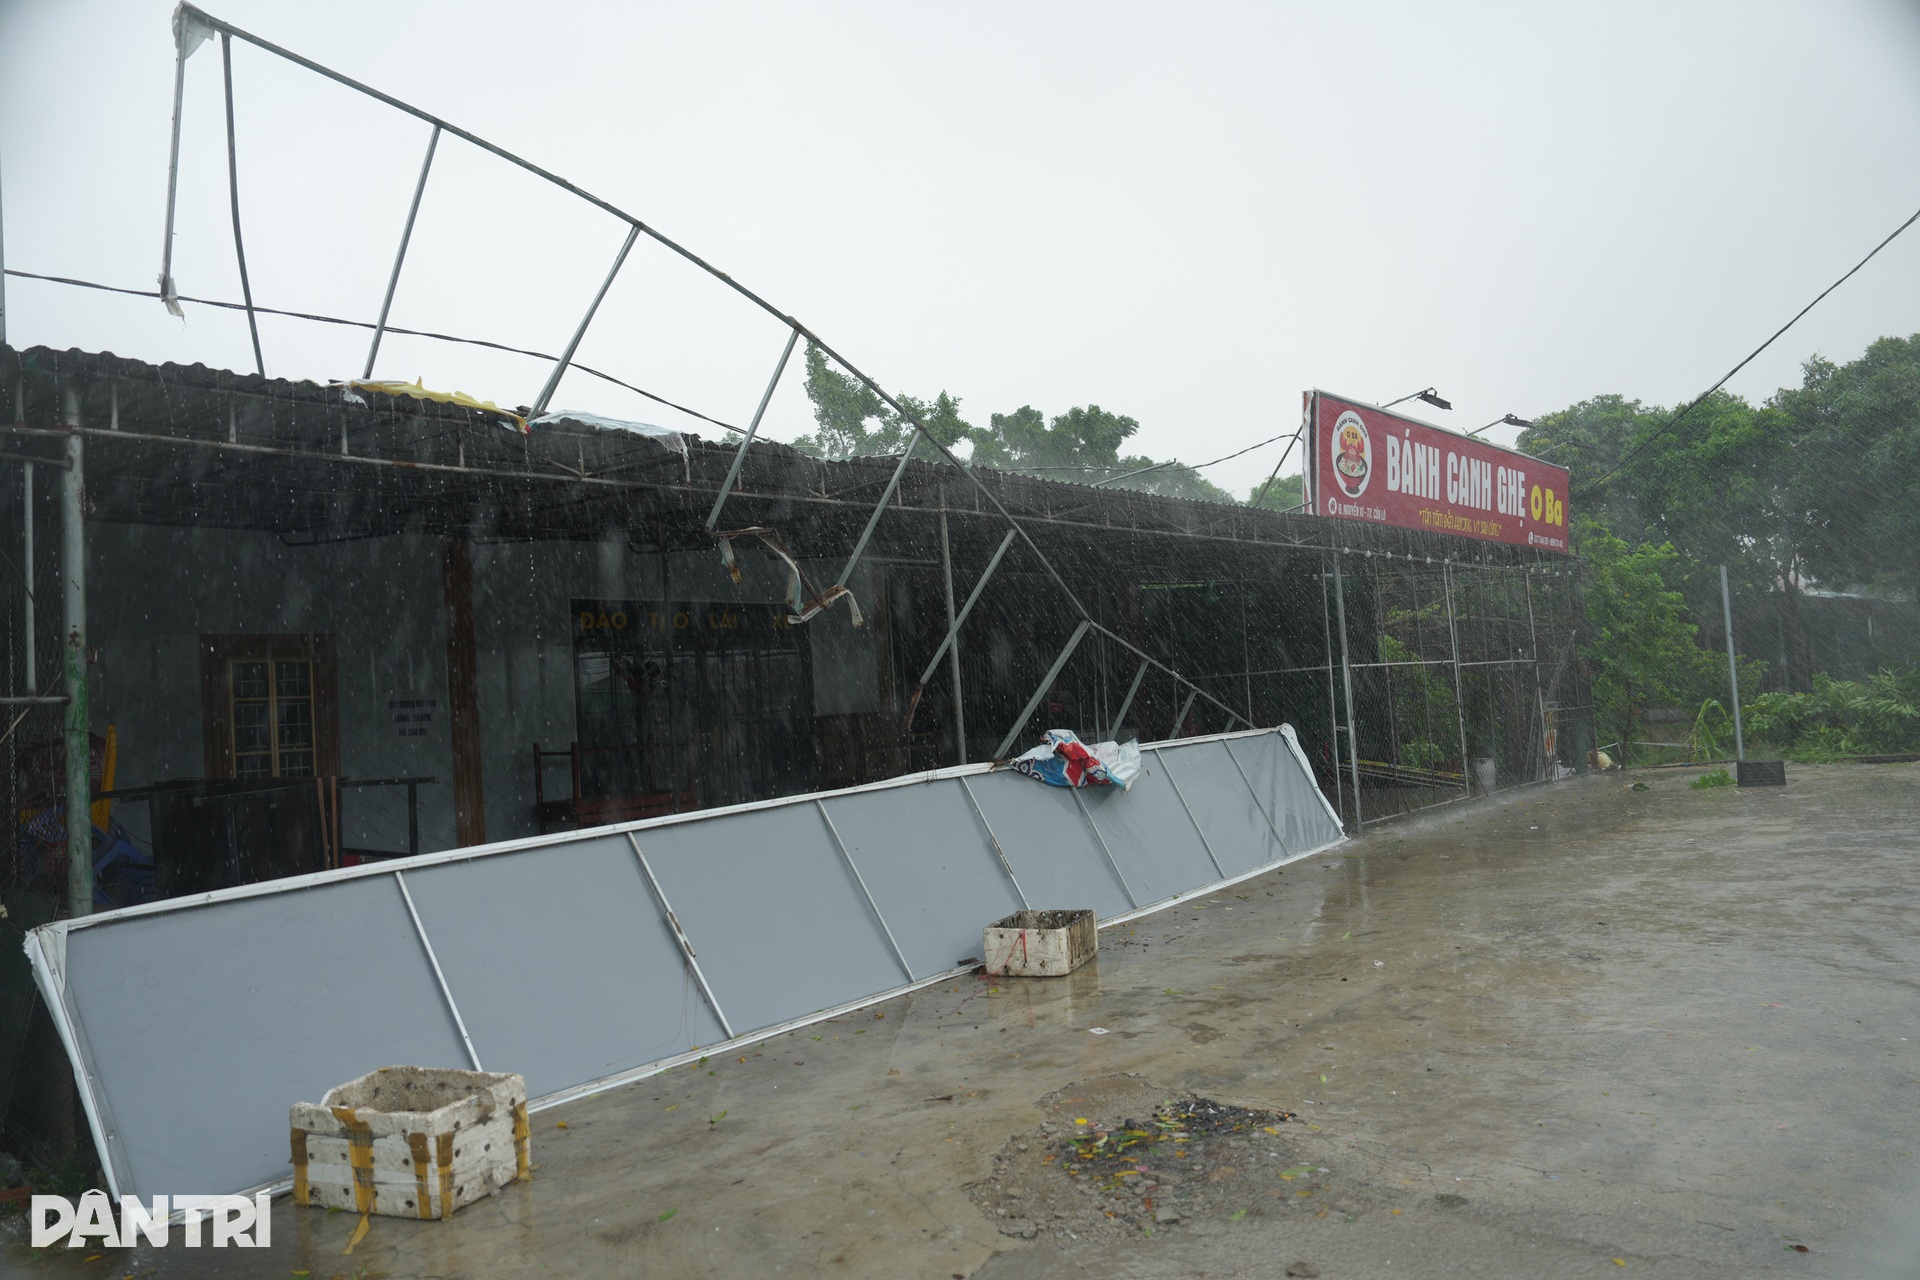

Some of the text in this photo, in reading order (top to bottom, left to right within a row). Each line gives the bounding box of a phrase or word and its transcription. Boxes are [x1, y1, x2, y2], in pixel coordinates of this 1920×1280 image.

[1386, 428, 1563, 528] BÁNH CANH GHẸ O Ba
[580, 606, 628, 630] ĐÀO
[649, 611, 689, 631] TO
[709, 608, 738, 630] LÁI
